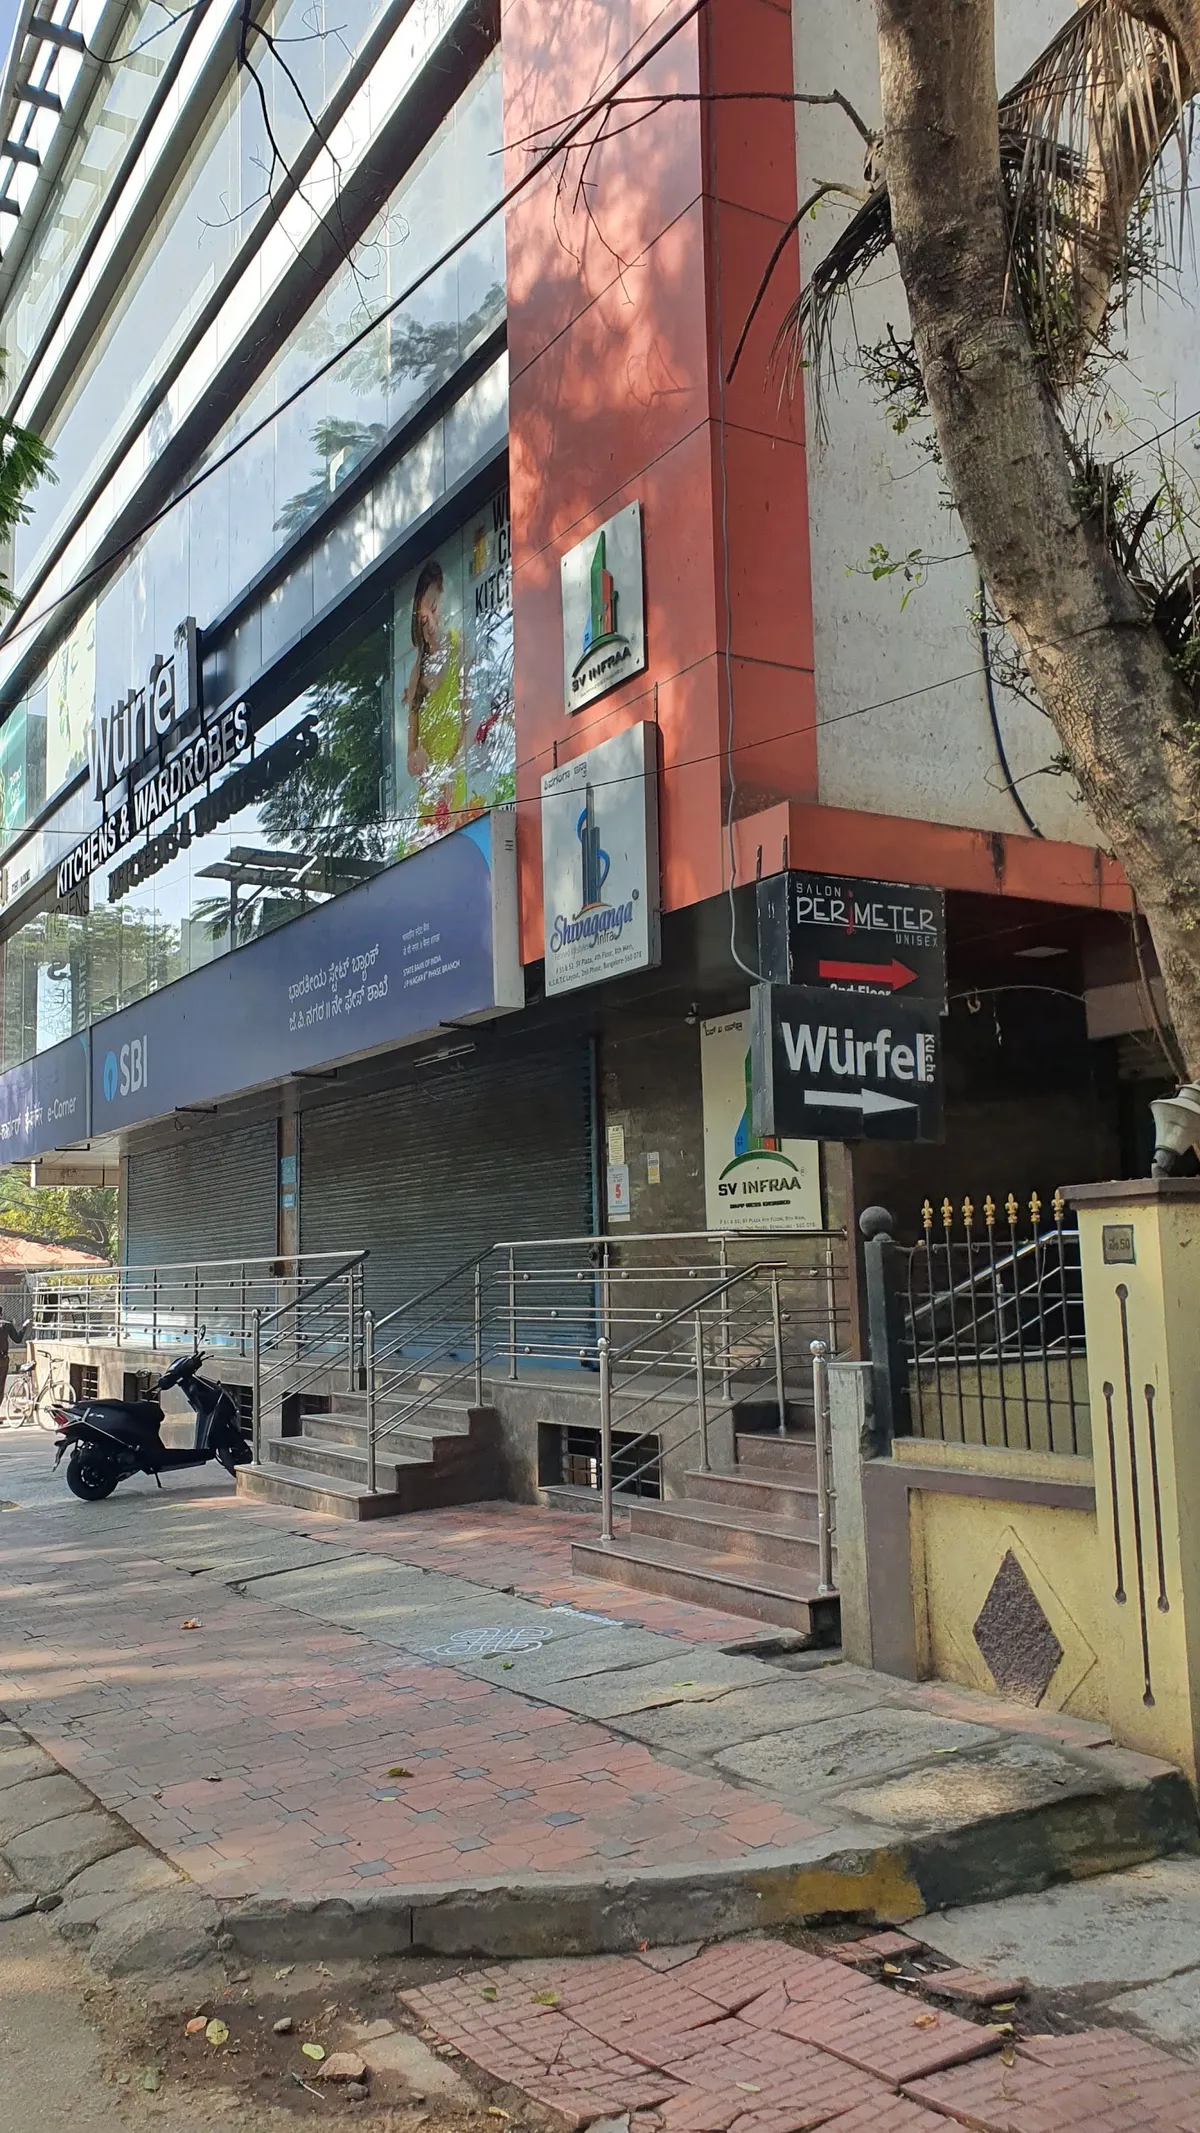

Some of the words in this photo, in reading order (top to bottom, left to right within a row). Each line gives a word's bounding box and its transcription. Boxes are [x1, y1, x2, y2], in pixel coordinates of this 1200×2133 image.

[56, 816, 117, 898] KITCHENS
[120, 804, 130, 843] &
[134, 702, 248, 832] WARDROBES
[796, 883, 842, 897] SALON
[550, 901, 633, 953] Shivaganga
[895, 934, 938, 947] UNISEX
[119, 1034, 148, 1096] SBI
[781, 1021, 926, 1082] Würfel
[47, 1097, 77, 1122] e-Corner
[718, 1182, 737, 1196] SV
[742, 1176, 801, 1195] INFRAA
